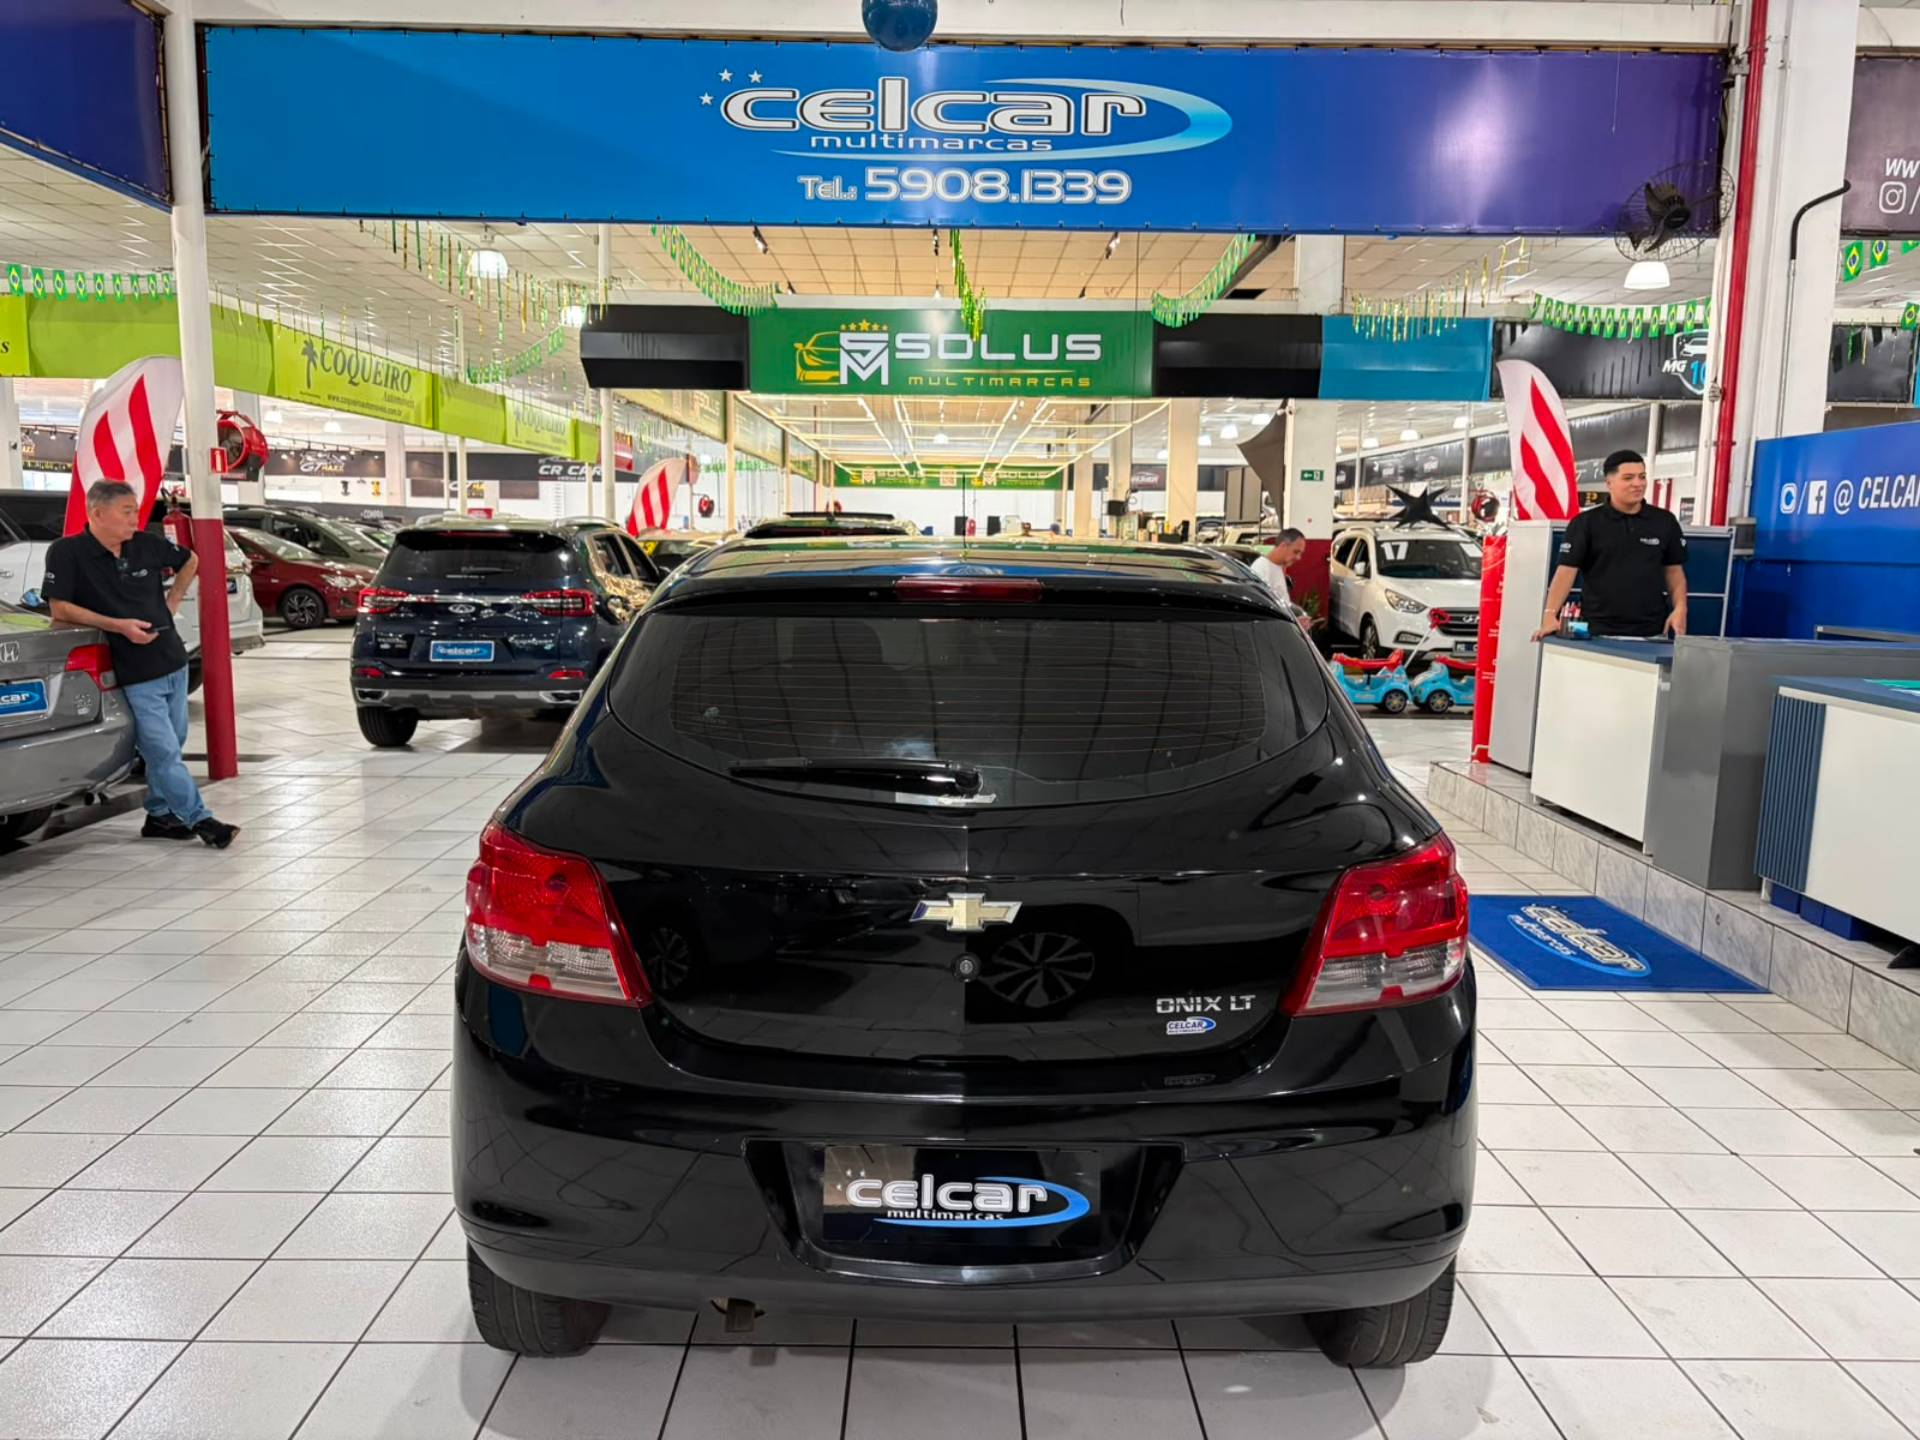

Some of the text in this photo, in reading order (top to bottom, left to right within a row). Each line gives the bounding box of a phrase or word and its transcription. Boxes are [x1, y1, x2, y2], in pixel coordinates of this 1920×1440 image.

[720, 76, 1147, 136] celcar
[811, 134, 1053, 151] multimarcas
[864, 166, 1132, 205] 5908.1339
[895, 332, 1102, 361] SOLUS
[319, 344, 412, 393] COQUEIRO
[1662, 359, 1688, 373] MG
[908, 376, 1091, 387] MULTIMARCAS
[538, 464, 563, 476] CR
[1858, 474, 1920, 509] CELCA
[1381, 541, 1408, 561] 17
[1156, 994, 1257, 1014] ONIX LT
[845, 1174, 1048, 1213] celcar
[886, 1208, 1006, 1222] multimarcas
